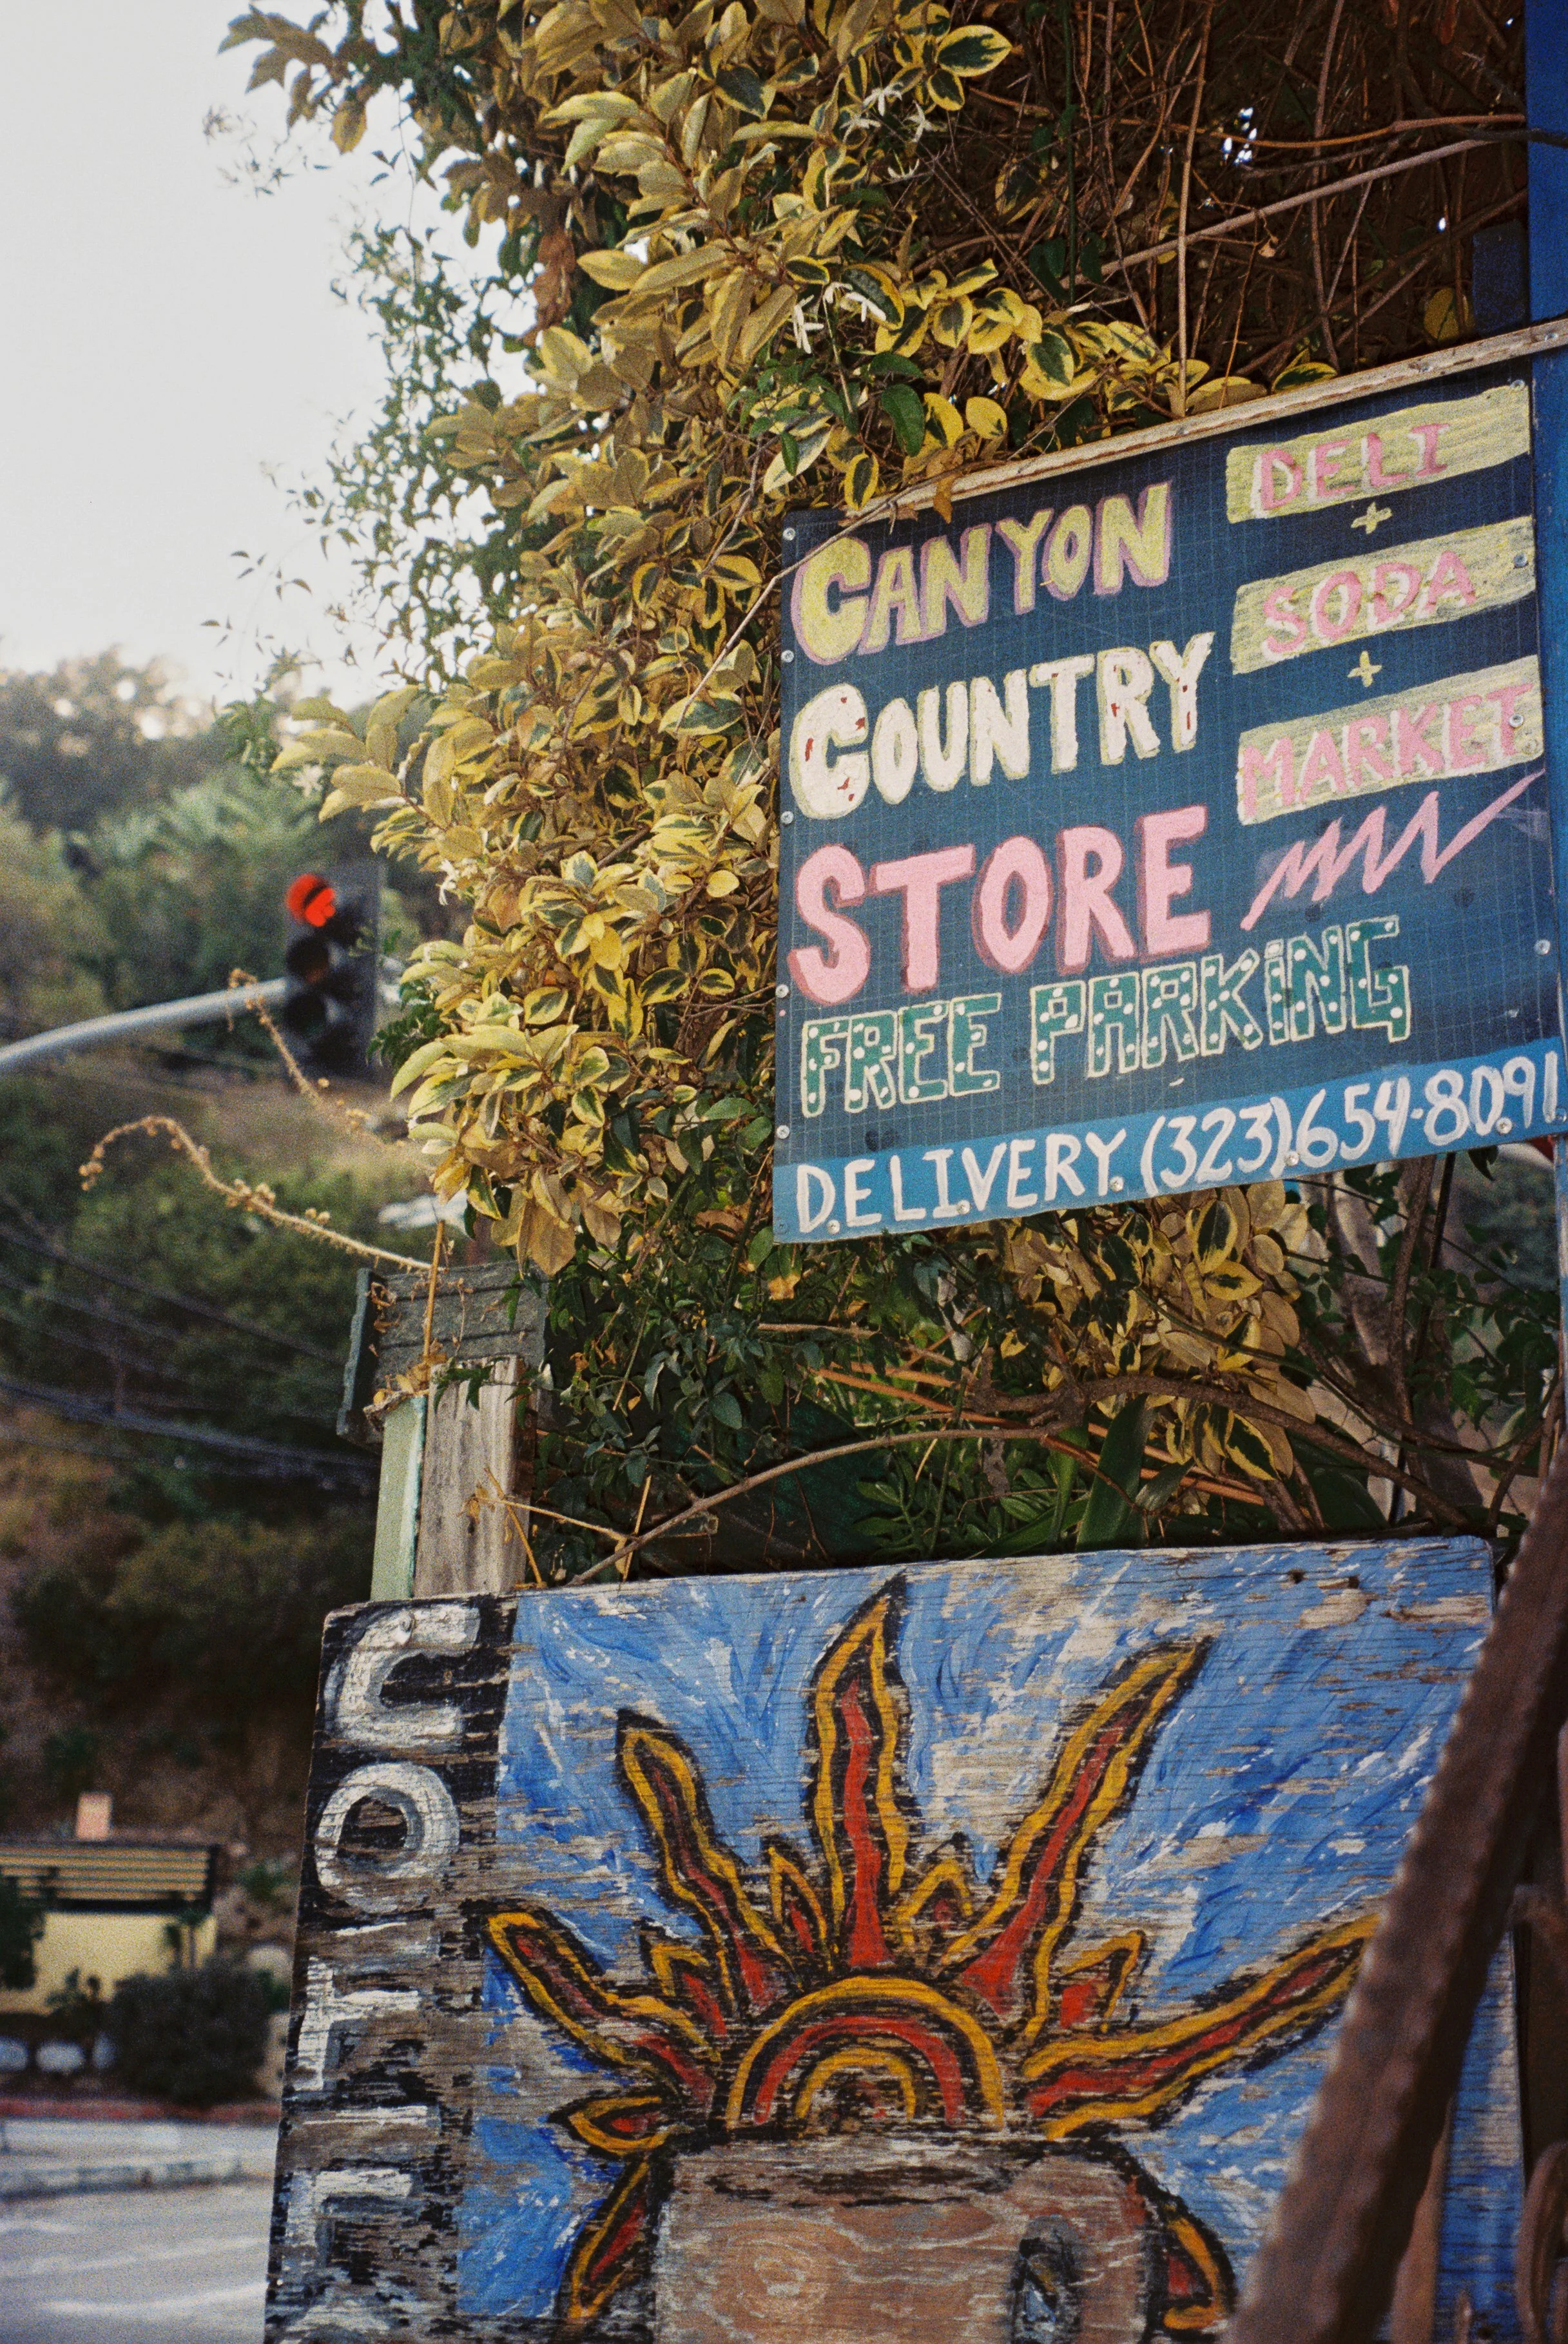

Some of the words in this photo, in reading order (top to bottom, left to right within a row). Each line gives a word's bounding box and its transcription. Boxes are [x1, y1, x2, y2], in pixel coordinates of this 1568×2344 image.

[1251, 423, 1451, 518] DELI
[791, 480, 1173, 665] CANYON
[1261, 550, 1476, 660] SODA
[789, 631, 1215, 820] COUNTRY
[1238, 683, 1534, 824] MARKET
[787, 805, 1210, 1005] STORE
[800, 993, 1002, 1118] FREE
[796, 1129, 1126, 1234] DELIVERY
